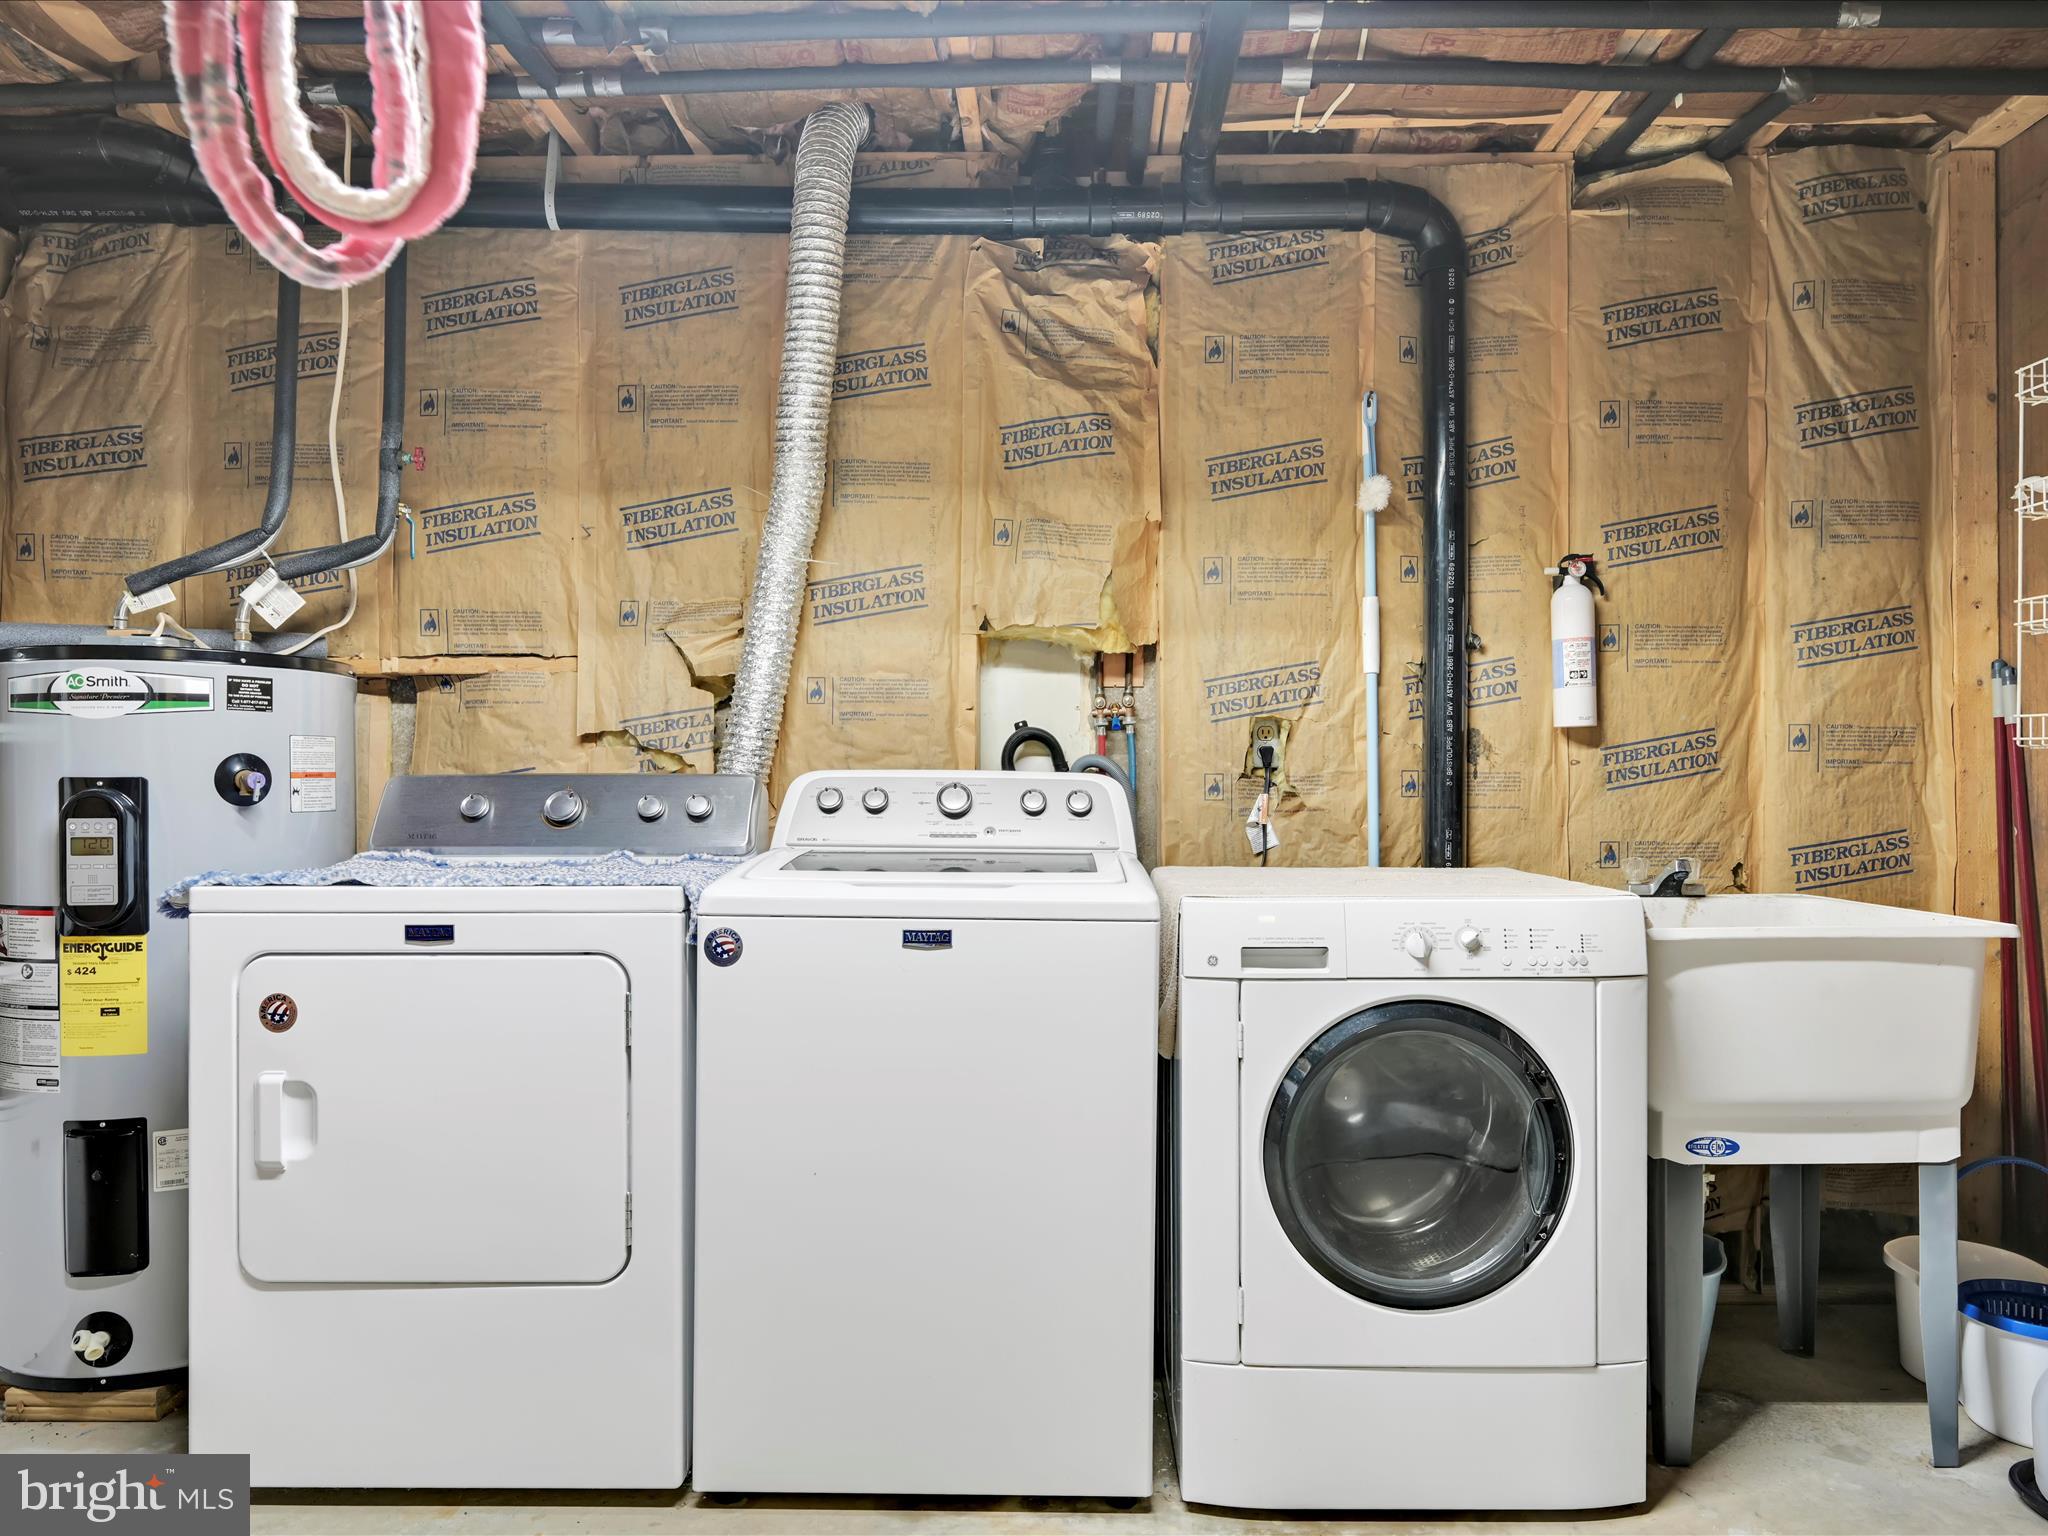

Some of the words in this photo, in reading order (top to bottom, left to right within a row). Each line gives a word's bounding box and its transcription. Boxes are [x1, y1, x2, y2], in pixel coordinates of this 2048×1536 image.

[1798, 173, 1909, 200] FIBERGLASS
[1136, 210, 1160, 219] 02589
[1802, 191, 1911, 217] INSULATION
[1208, 229, 1324, 262] FIBERGLASS
[1212, 246, 1327, 278] INSULATION
[422, 282, 537, 314] FIBERGLASS
[620, 272, 735, 304] FIBERGLASS
[427, 301, 538, 331] INSULATION
[624, 290, 736, 322] INSULATION
[1602, 292, 1719, 325] FIBERGLASS
[1606, 310, 1721, 343] INSULATION
[228, 337, 340, 368] FIBERASS
[834, 349, 927, 377] BERGLASS
[230, 353, 340, 385] INSUTION
[831, 367, 928, 394] SULATION
[1796, 390, 1915, 425] FIBERGLASS
[1001, 418, 1112, 446] FIBERGLASS
[1448, 420, 1456, 433] ABS
[1801, 409, 1917, 442] INSULATION
[20, 432, 143, 457] FIBERGLASS
[1004, 435, 1113, 463] INSULATION
[23, 446, 145, 475] INSULATION
[1207, 444, 1324, 478] FIBERGLASS
[1211, 462, 1325, 495] INSULATION
[422, 498, 537, 529] FIBERGLASS
[622, 494, 733, 526] FIBERGLASS
[426, 516, 538, 547] INSULATION
[626, 512, 736, 543] INSULATION
[1603, 512, 1719, 544] FIBERGLASS
[1607, 529, 1720, 560] INSULATION
[809, 570, 924, 602] FIBERGLASS
[813, 588, 927, 619] INSULATION
[1447, 606, 1454, 615] 40
[1793, 611, 1914, 643] FIBERGLASS
[1797, 629, 1915, 661] INSULATION
[86, 675, 128, 687] Smith
[1206, 665, 1321, 699] FIBERGLASS
[1210, 685, 1321, 716] INSULATION
[622, 713, 713, 737] IBERGLA
[1603, 734, 1717, 767] FIBERGLASS
[1606, 751, 1719, 784] INSULATION
[83, 839, 110, 849] 120
[1791, 836, 1909, 867] FIBERGLASS
[1795, 853, 1911, 884] INSULATION
[63, 942, 143, 953] ENERGYGUIDE
[708, 928, 740, 944] AMERICA
[904, 932, 950, 942] MAYTAG
[66, 968, 72, 976] $
[74, 966, 97, 975] 424
[261, 994, 287, 1019] AMERICA
